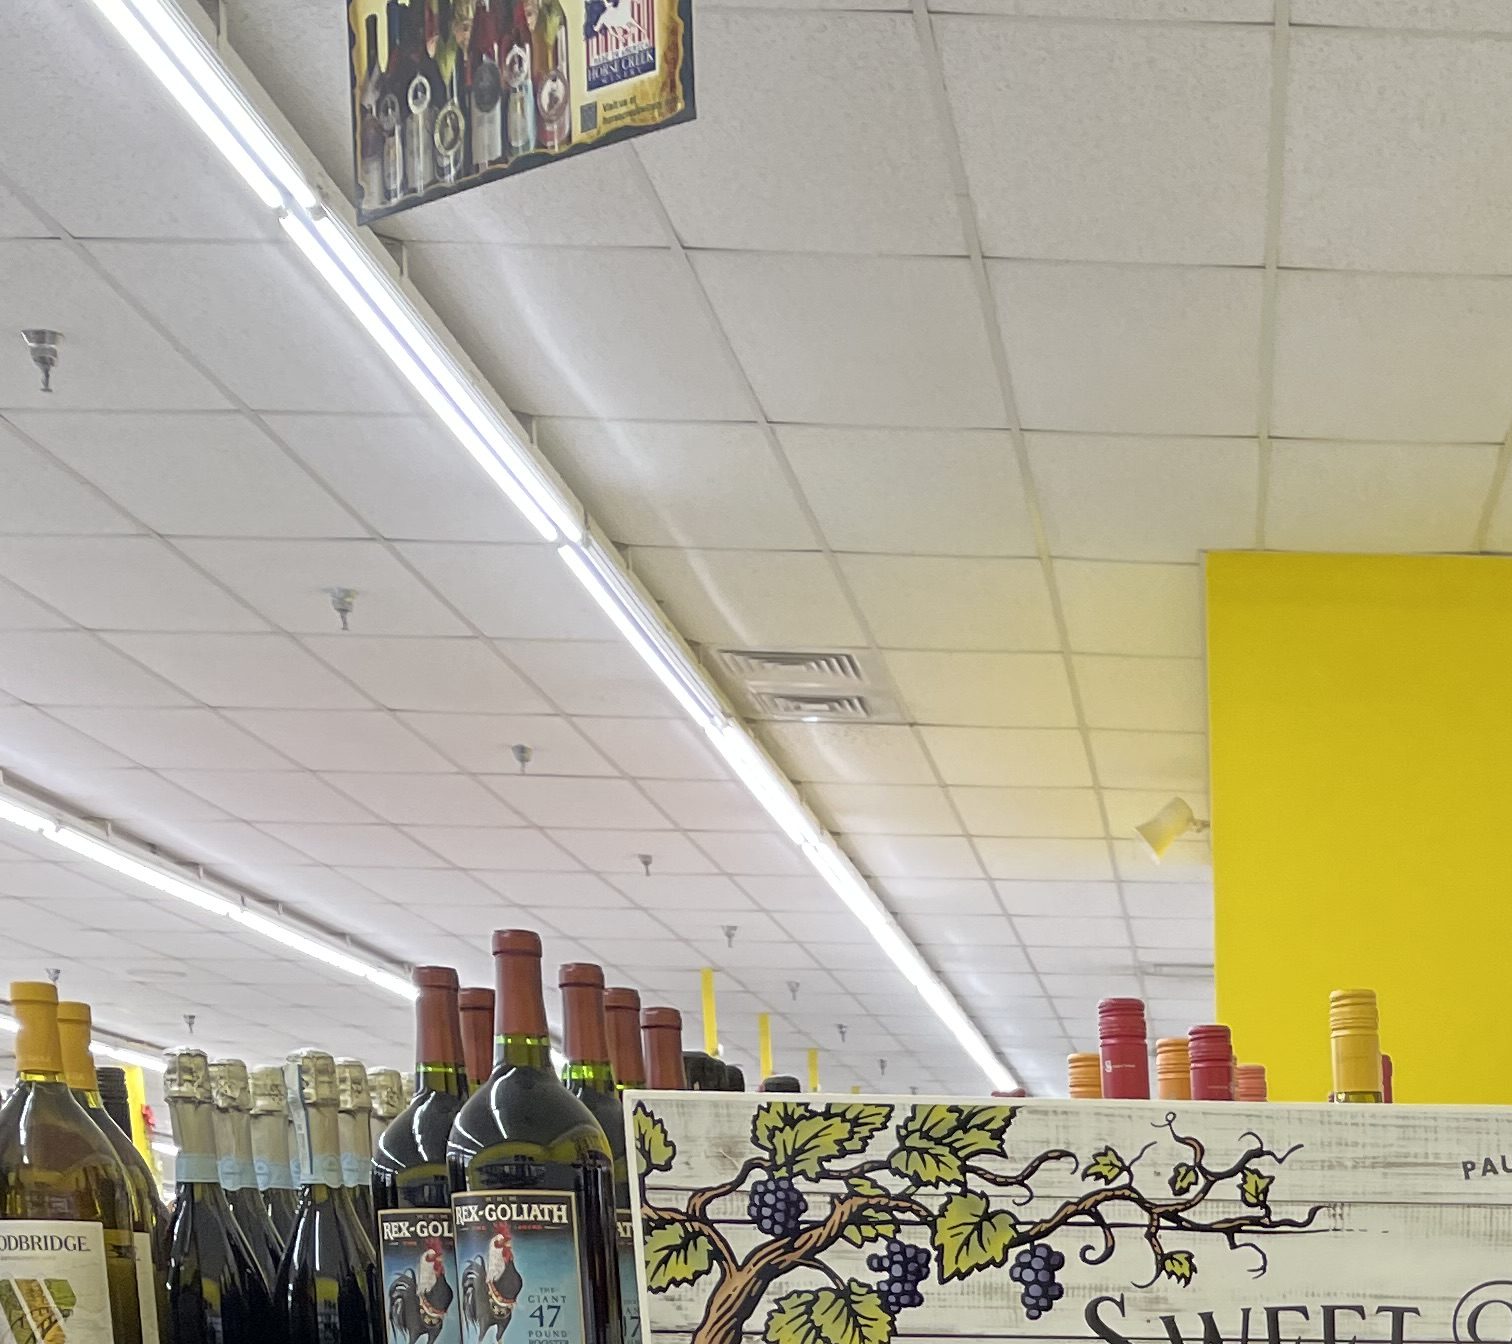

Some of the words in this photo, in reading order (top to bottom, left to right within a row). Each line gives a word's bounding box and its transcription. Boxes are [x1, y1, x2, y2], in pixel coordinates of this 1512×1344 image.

[455, 1203, 569, 1226] REX-GOLIATH
[528, 1295, 567, 1304] GIANT
[529, 1305, 562, 1328] 47
[528, 1330, 568, 1338] POUND
